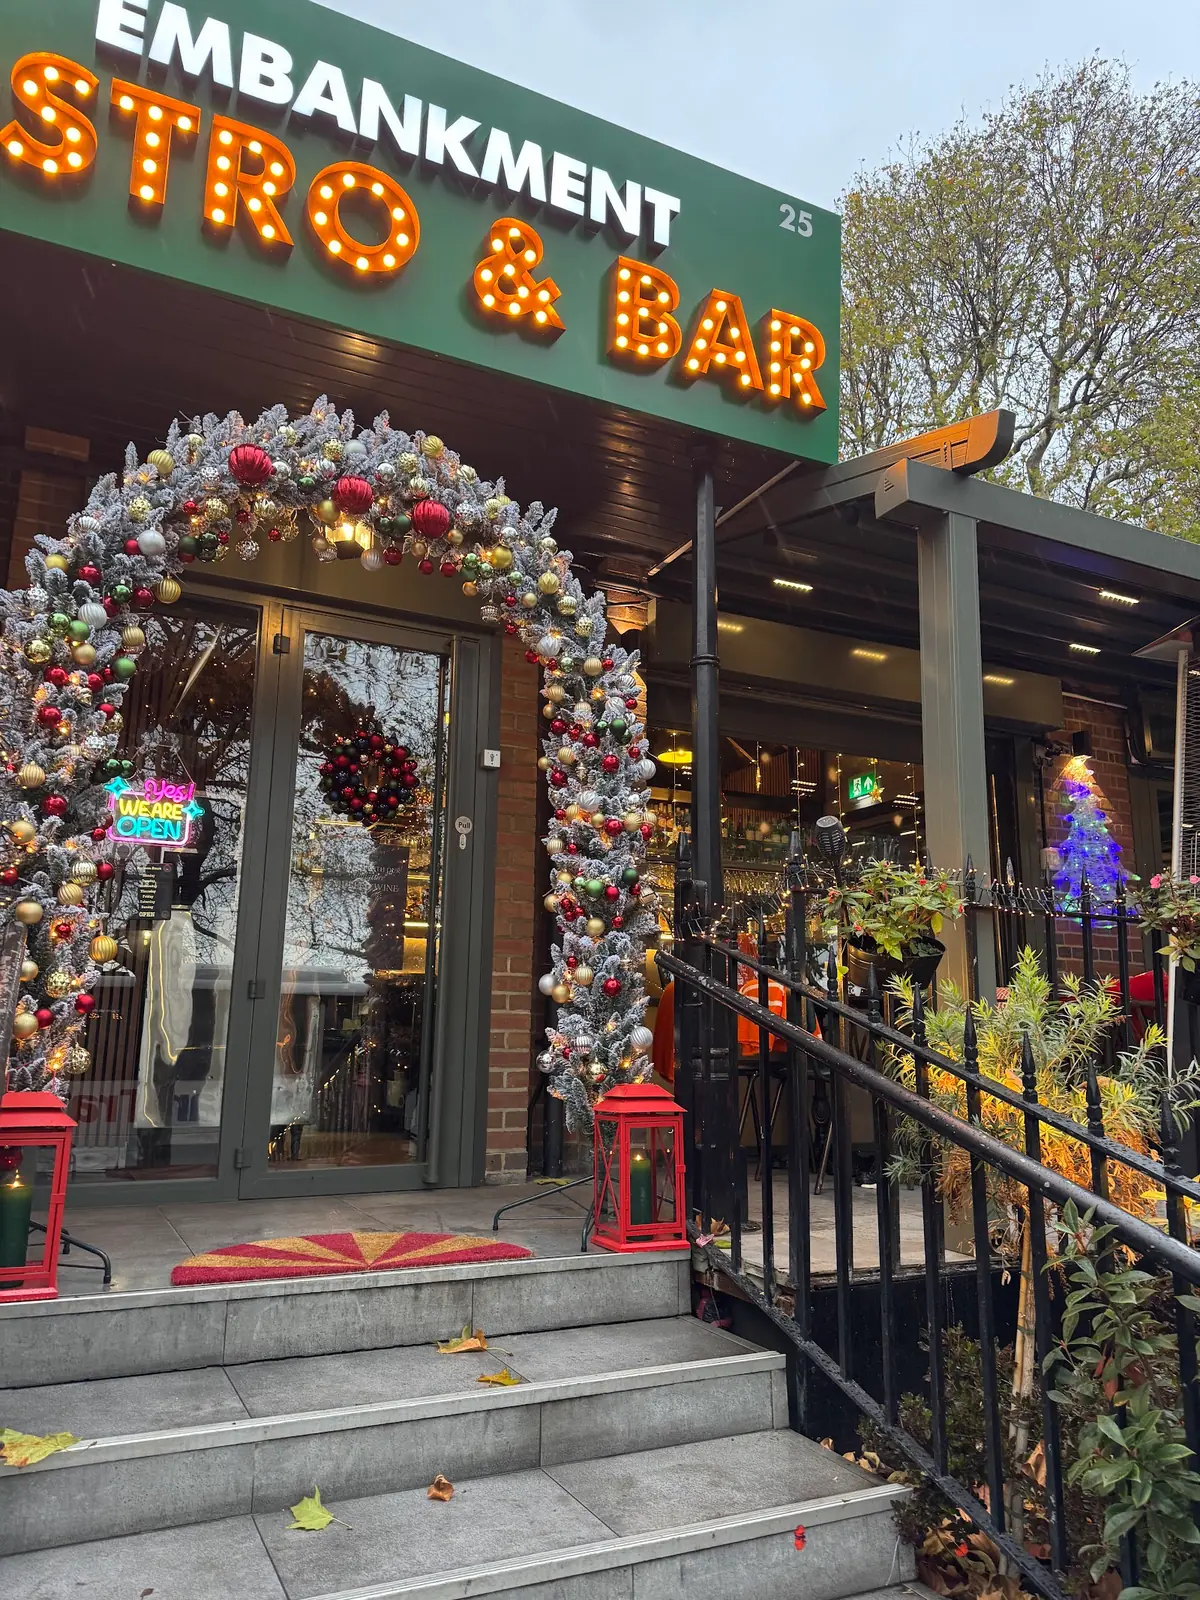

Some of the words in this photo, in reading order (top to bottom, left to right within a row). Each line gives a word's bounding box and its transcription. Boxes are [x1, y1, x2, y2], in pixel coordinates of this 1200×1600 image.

[95, 0, 681, 247] EMBANKMENT
[779, 203, 814, 239] 25
[473, 217, 566, 333] &
[607, 255, 828, 411] BAR
[144, 777, 197, 803] Yes!
[116, 815, 182, 841] OPEN
[458, 821, 471, 829] Pull
[374, 883, 399, 893] WINE
